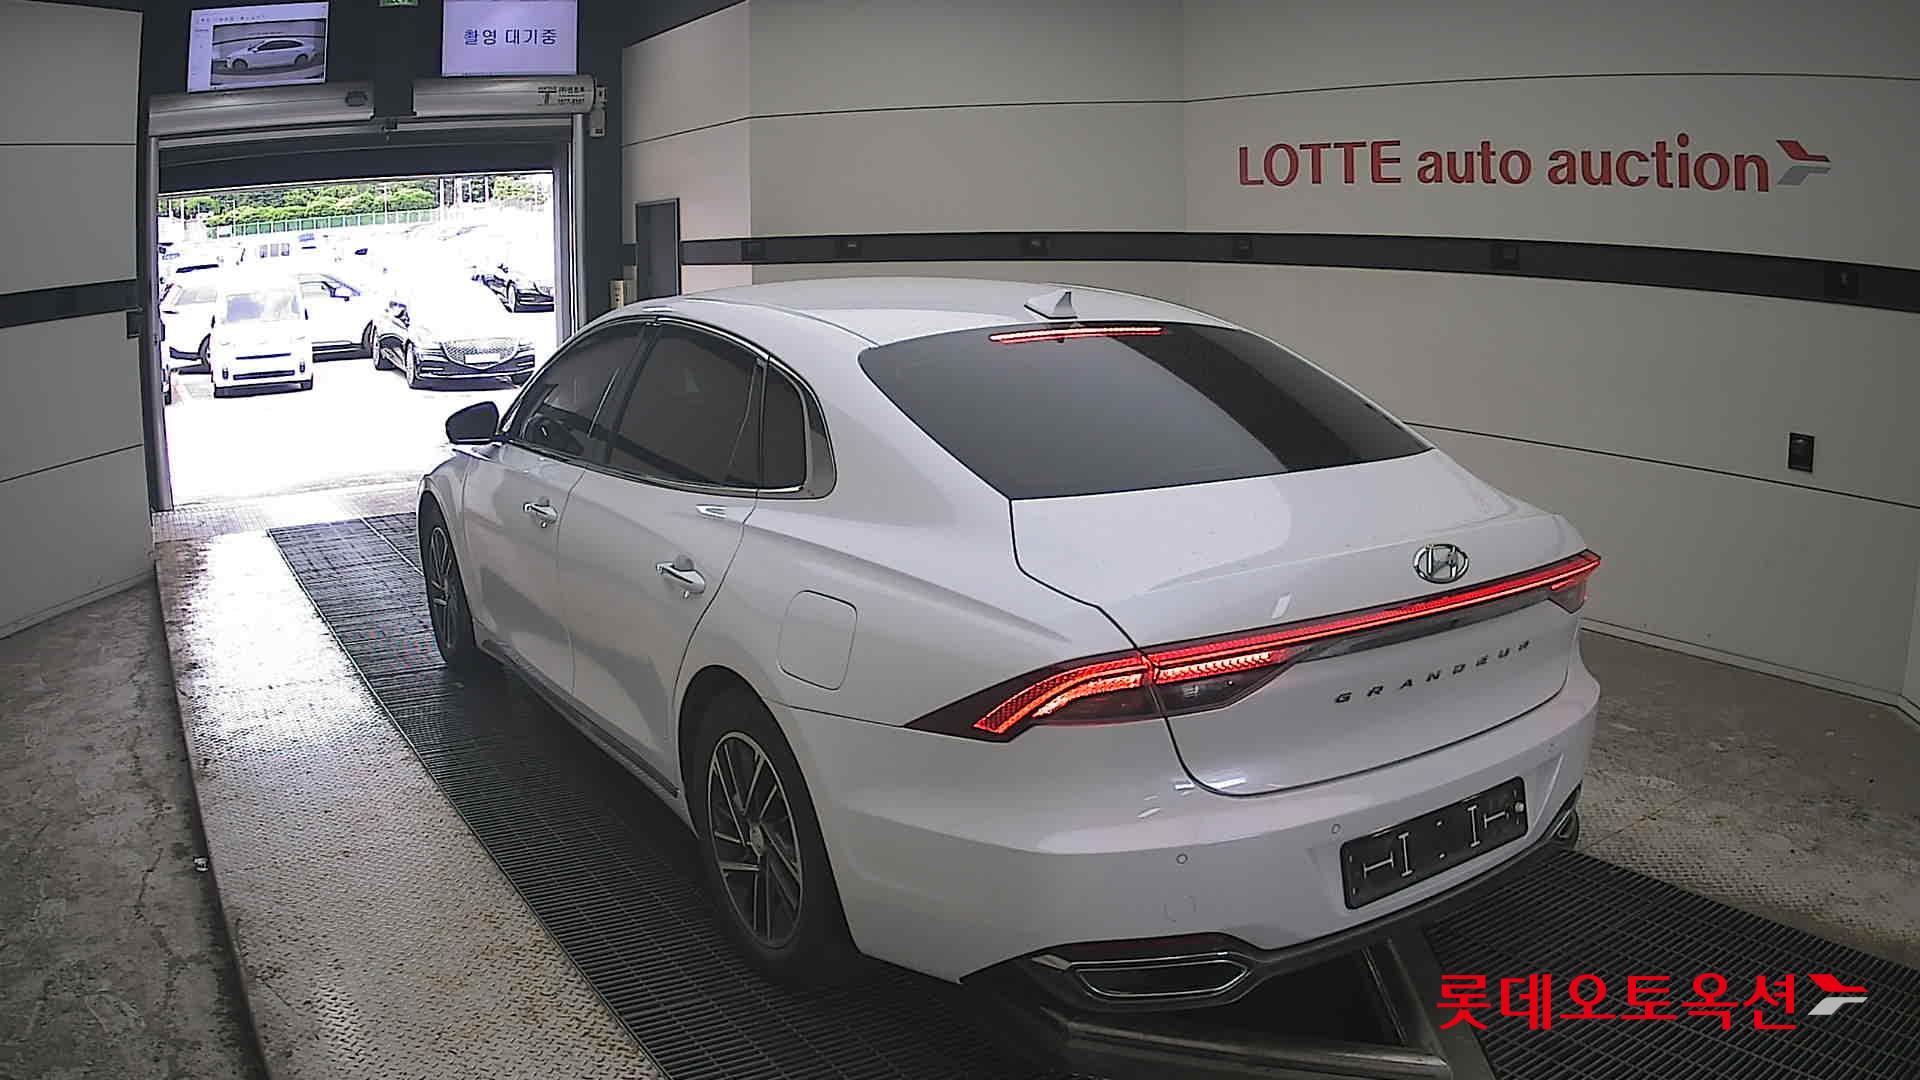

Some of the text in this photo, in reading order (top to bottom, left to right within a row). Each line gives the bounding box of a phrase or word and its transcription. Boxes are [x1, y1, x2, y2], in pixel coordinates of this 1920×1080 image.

[464, 27, 556, 46] 촬영 대기중
[1238, 134, 1770, 192] LOTTE auto auction
[1334, 640, 1531, 704] GRANDEUR
